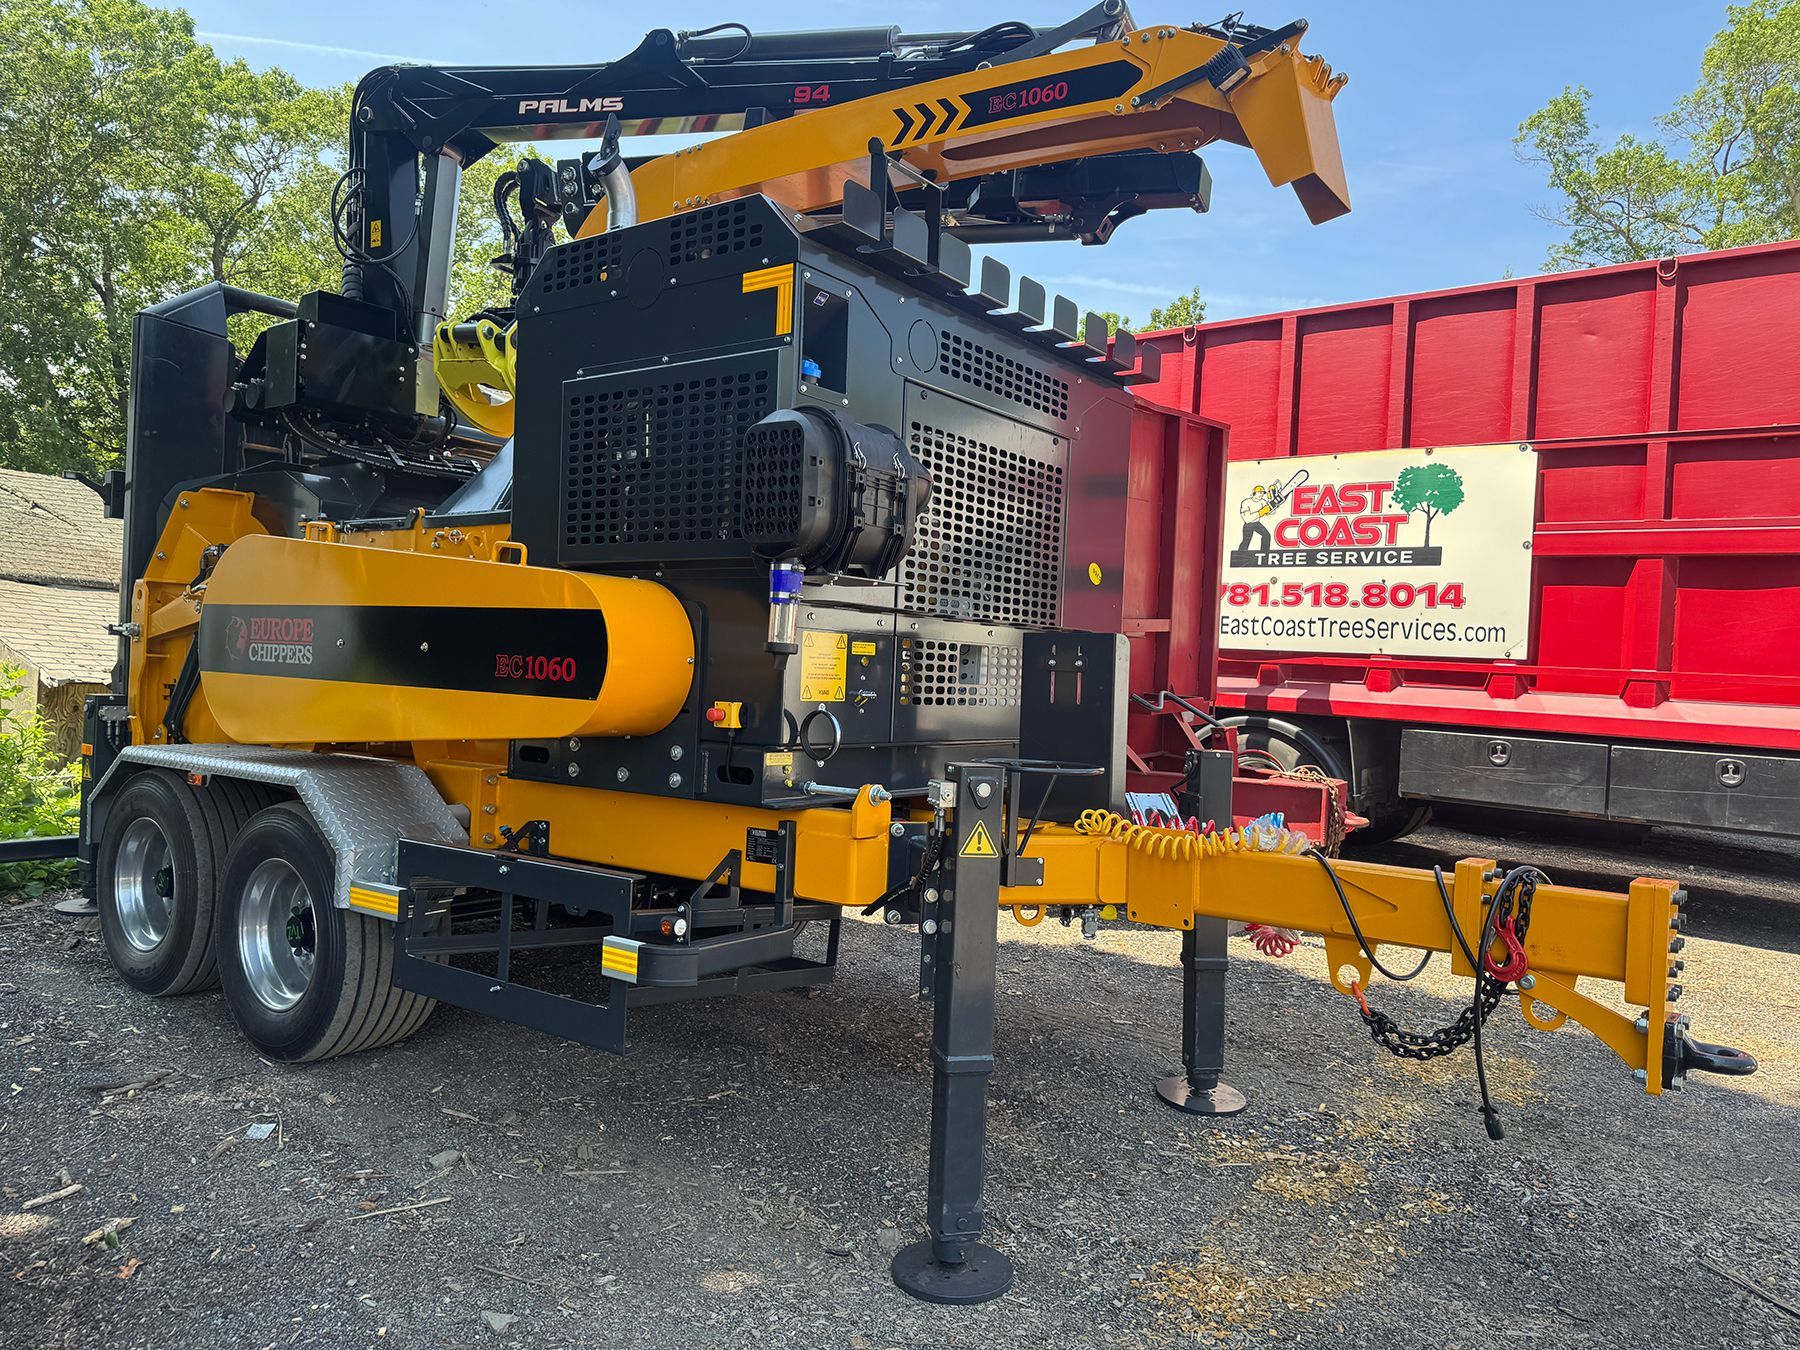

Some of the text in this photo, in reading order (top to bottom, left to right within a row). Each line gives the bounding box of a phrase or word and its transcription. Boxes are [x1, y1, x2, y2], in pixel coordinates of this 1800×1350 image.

[518, 96, 624, 114] PALMS
[989, 81, 1069, 113] EC1060
[1290, 481, 1394, 516] EAST
[1274, 515, 1409, 548] COAST
[1255, 551, 1413, 565] TREE SERVICE
[249, 618, 314, 642] EUROPE
[1220, 616, 1506, 643] EastCoastTreeServices.com
[249, 643, 312, 665] CHIPPERS
[495, 654, 576, 681] EC1060
